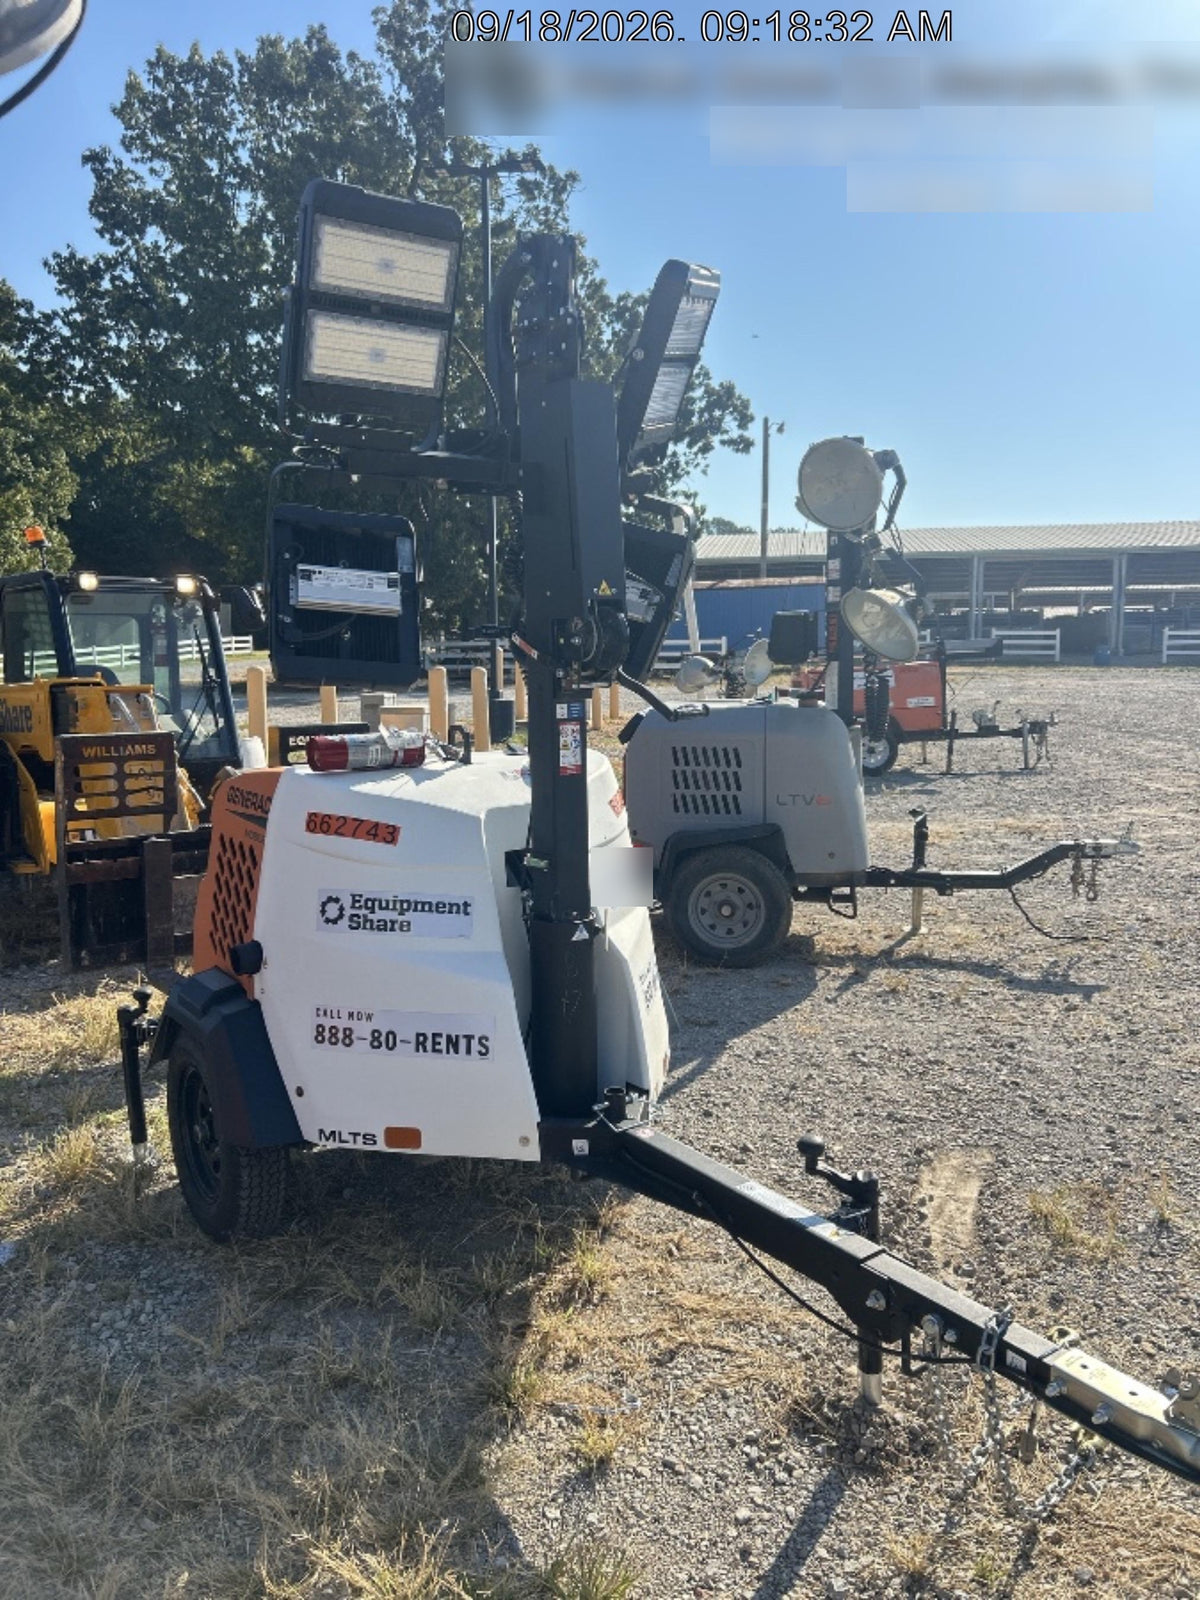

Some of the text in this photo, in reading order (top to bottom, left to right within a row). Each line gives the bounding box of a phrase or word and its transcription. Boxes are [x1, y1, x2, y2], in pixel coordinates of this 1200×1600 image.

[82, 744, 157, 758] WILLIAMS
[227, 785, 273, 815] GENERAC
[305, 811, 398, 845] 662743
[349, 893, 472, 916] Equipment
[348, 913, 412, 933] Share
[315, 1007, 375, 1022] CALL NOW
[313, 1023, 491, 1058] 888-80-RENTS
[317, 1128, 379, 1146] MLTS
